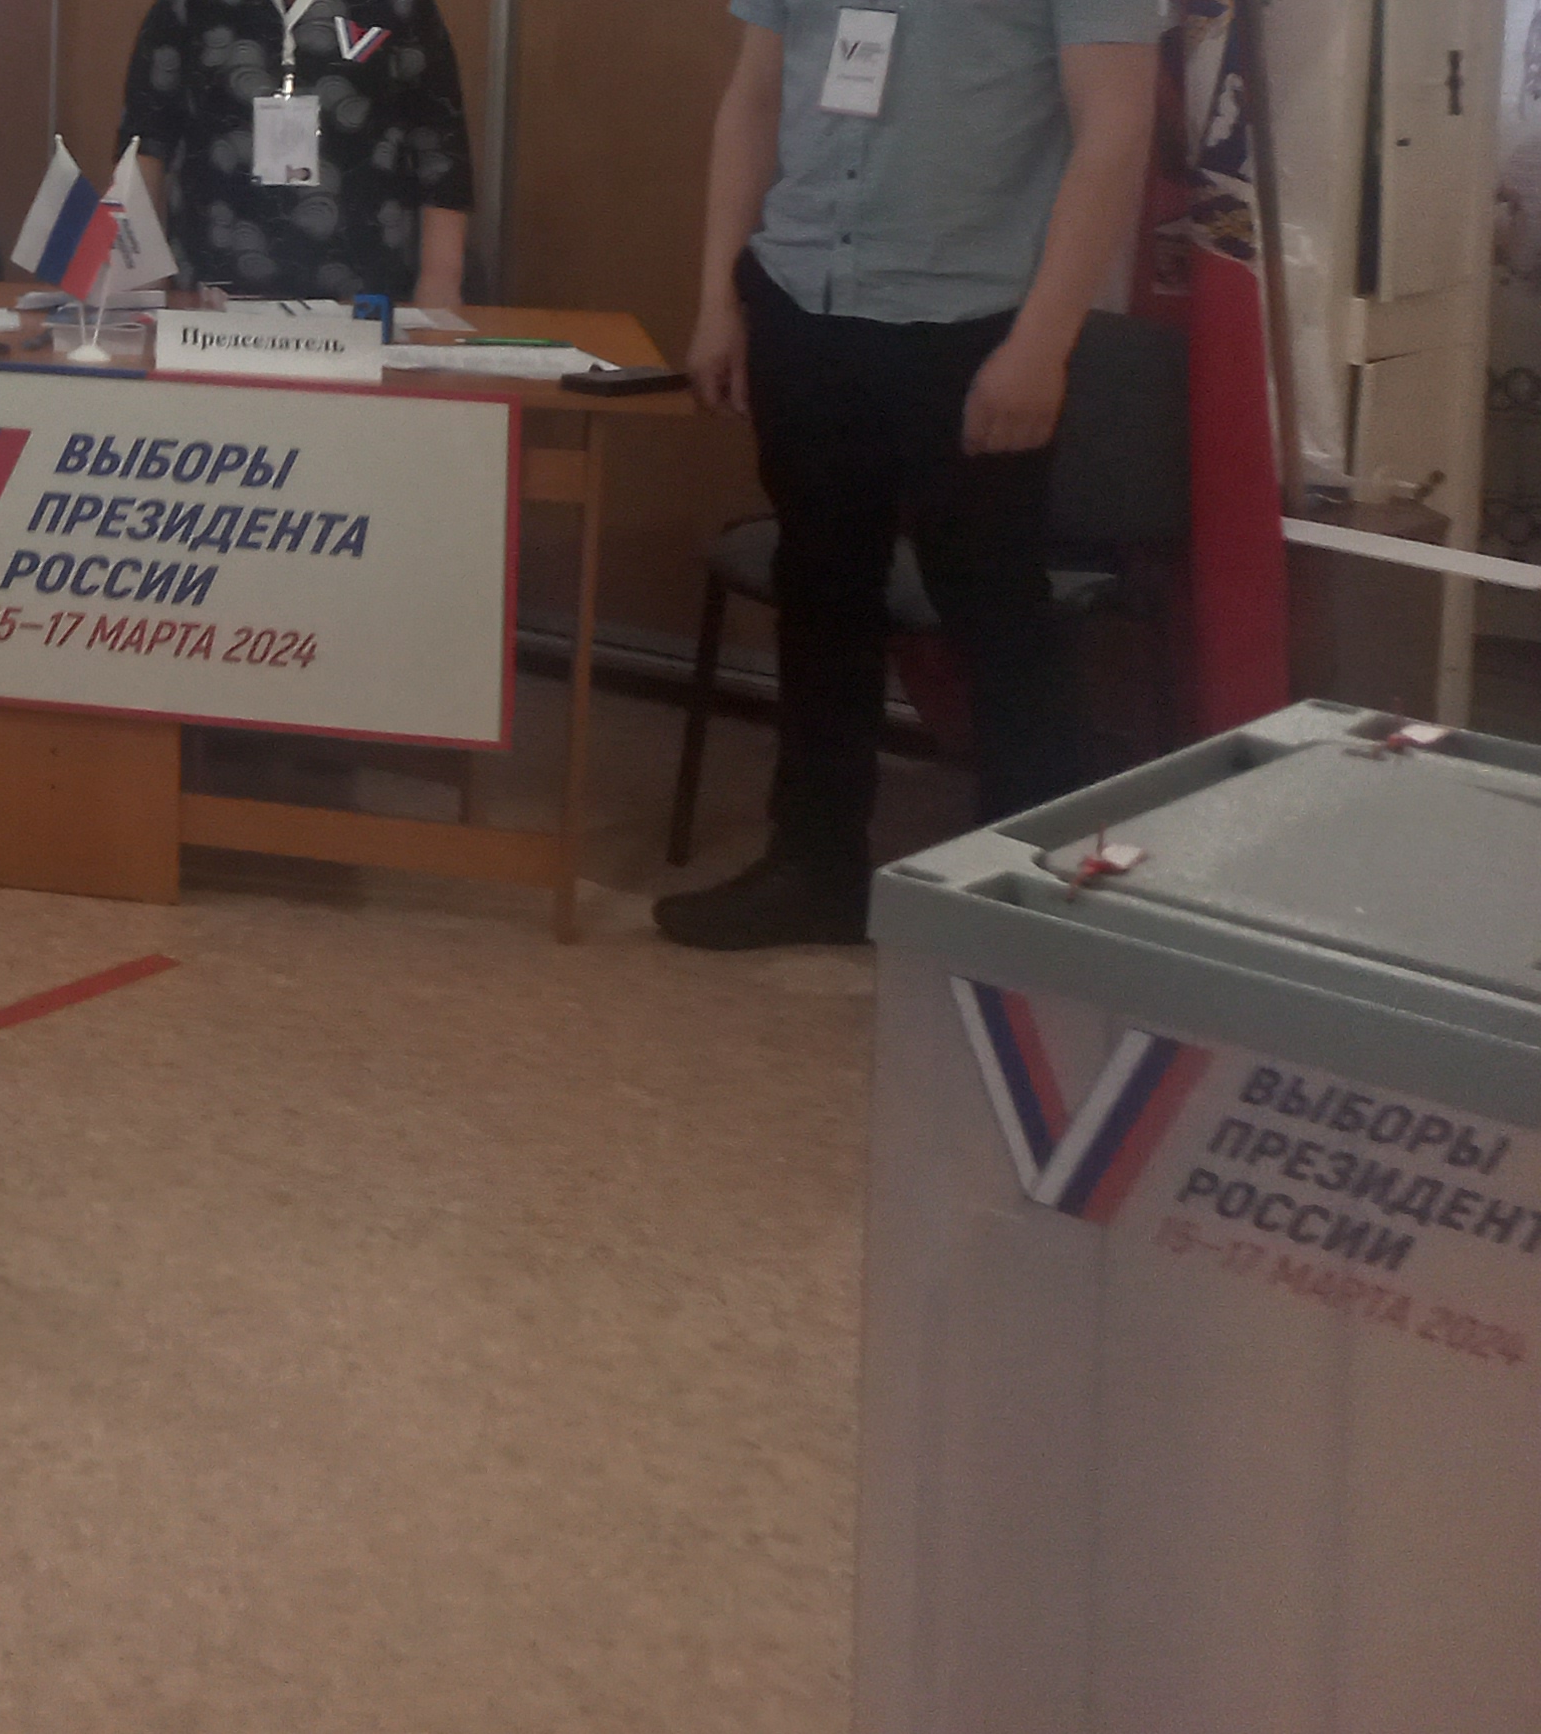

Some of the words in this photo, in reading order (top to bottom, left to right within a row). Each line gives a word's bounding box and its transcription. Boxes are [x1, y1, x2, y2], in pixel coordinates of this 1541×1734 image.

[180, 326, 346, 354] Председатель
[54, 432, 301, 490] ВЫБОРЫ
[27, 491, 371, 559] ПРЕЗИДЕНТА
[0, 549, 220, 607] РОССИИ
[85, 613, 217, 661] МАРТА
[223, 626, 319, 668] 2024
[1238, 1067, 1511, 1176] ВЫБОРЫ
[1176, 1167, 1415, 1271] РОССИИ
